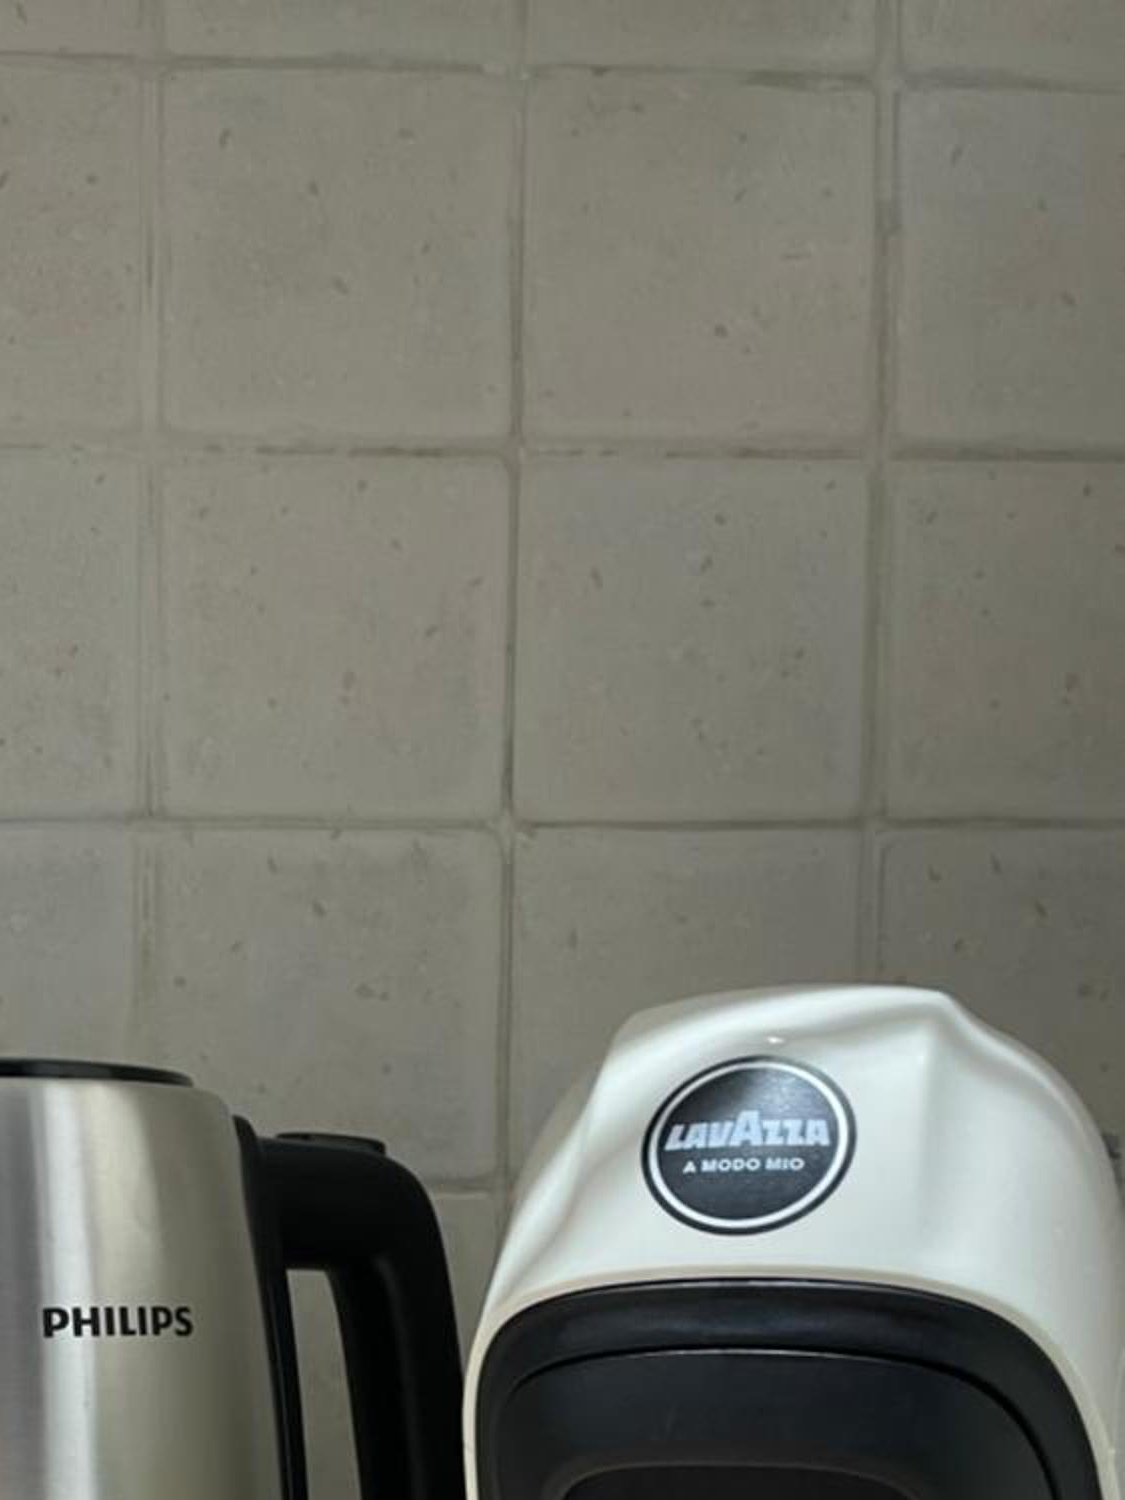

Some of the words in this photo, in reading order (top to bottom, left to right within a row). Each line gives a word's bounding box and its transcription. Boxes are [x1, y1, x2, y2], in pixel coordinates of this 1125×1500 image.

[665, 1110, 830, 1150] LAVAZZA
[682, 1160, 697, 1174] A
[701, 1157, 761, 1172] MODO
[765, 1157, 805, 1170] MIO
[43, 1306, 194, 1337] PHILIPS
